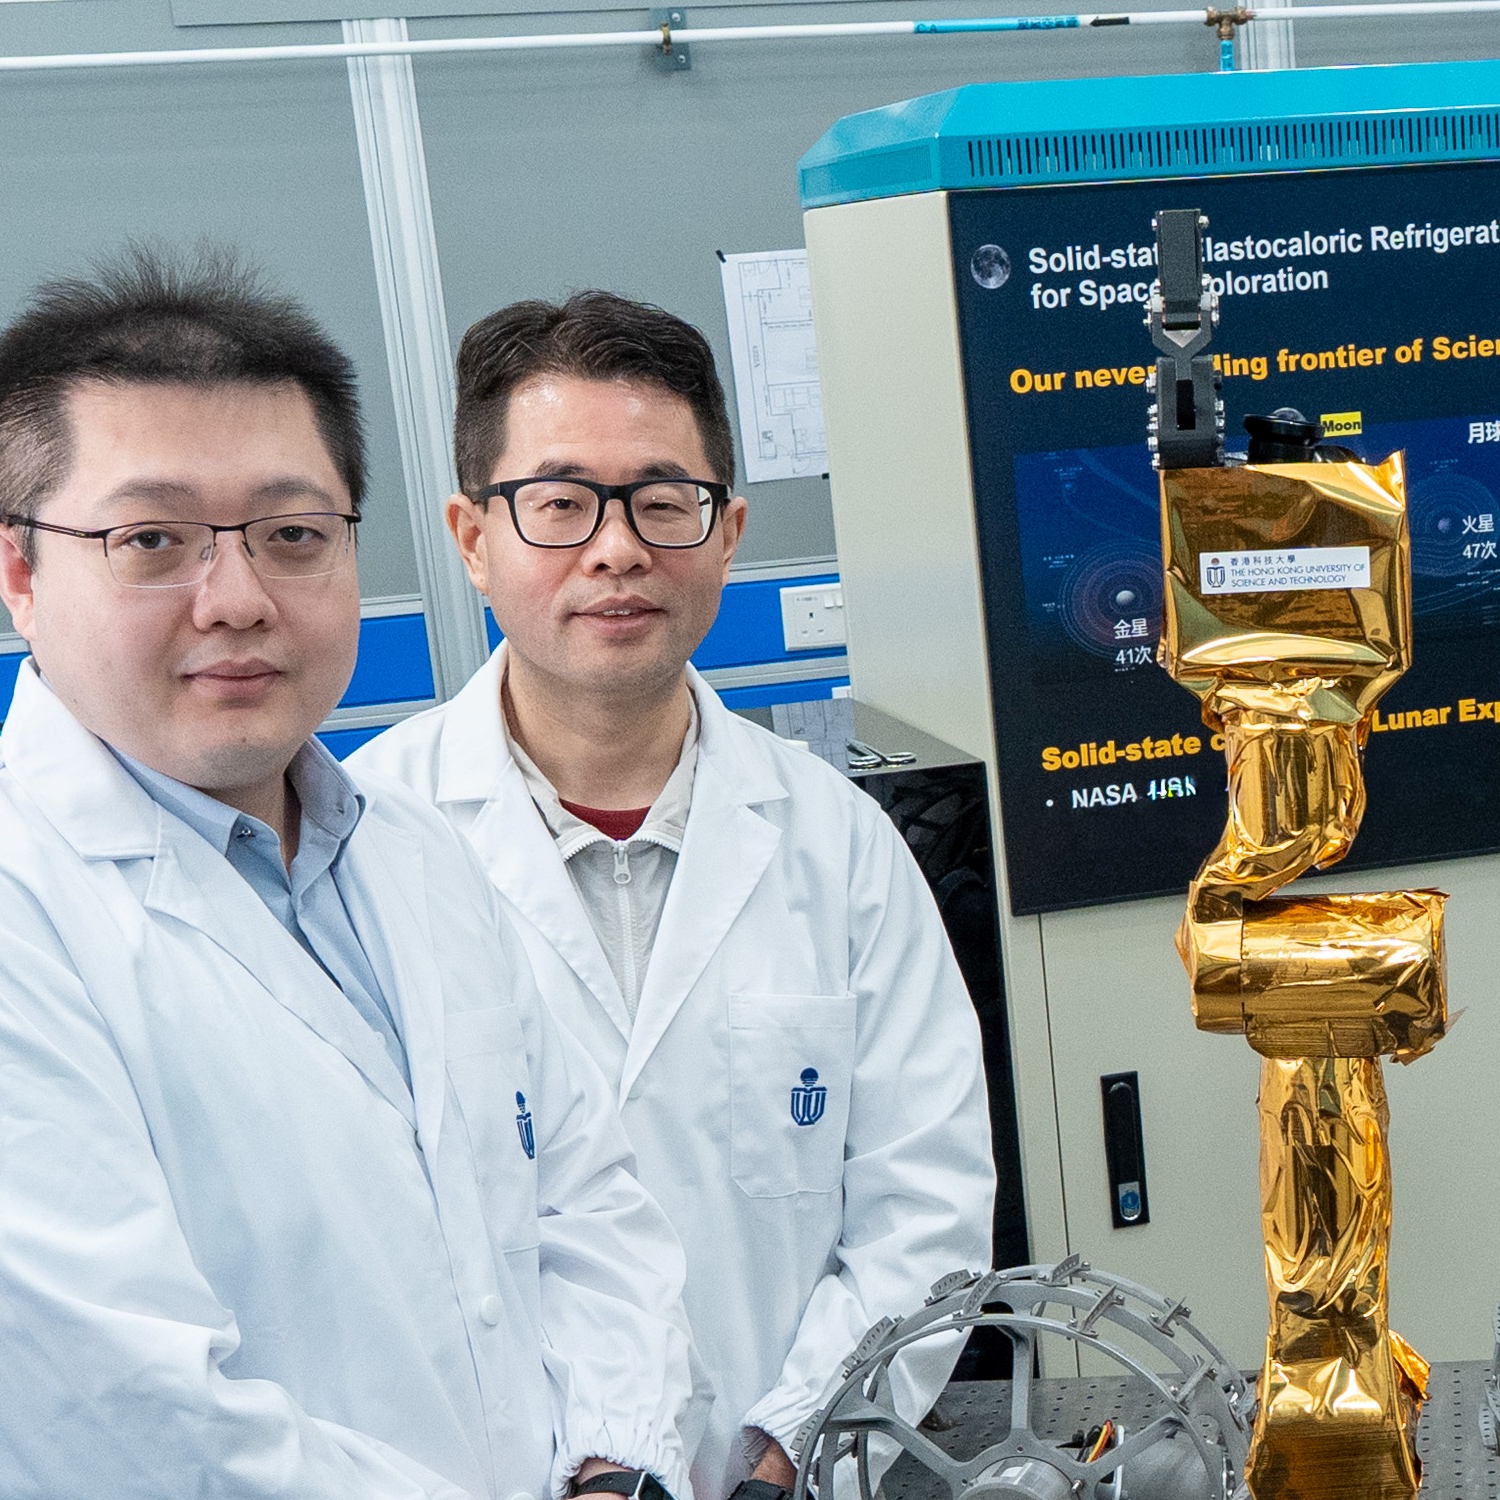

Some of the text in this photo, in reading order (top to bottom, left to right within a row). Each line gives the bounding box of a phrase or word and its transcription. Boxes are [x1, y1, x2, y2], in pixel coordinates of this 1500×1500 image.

[1029, 242, 1159, 274] Solid-stat
[1201, 228, 1362, 263] lastocaloric
[1031, 283, 1071, 309] for
[1010, 368, 1066, 394] Our
[1277, 344, 1386, 373] frontier
[1395, 339, 1423, 363] of
[1322, 420, 1361, 433] Moon
[1462, 514, 1495, 535] 火星
[1230, 554, 1296, 566] 香港科技大學
[1463, 541, 1497, 559] 47次
[1231, 563, 1365, 577] THE HONG KONG UNIVERSITY OF
[1232, 574, 1347, 587] SCIENCE AND TECHNOLOGY
[1113, 618, 1149, 640] 金星
[1116, 645, 1152, 665] 41次
[1372, 705, 1451, 732] Lunar
[1041, 732, 1201, 771] Solid-state
[1071, 782, 1138, 809] NASA
